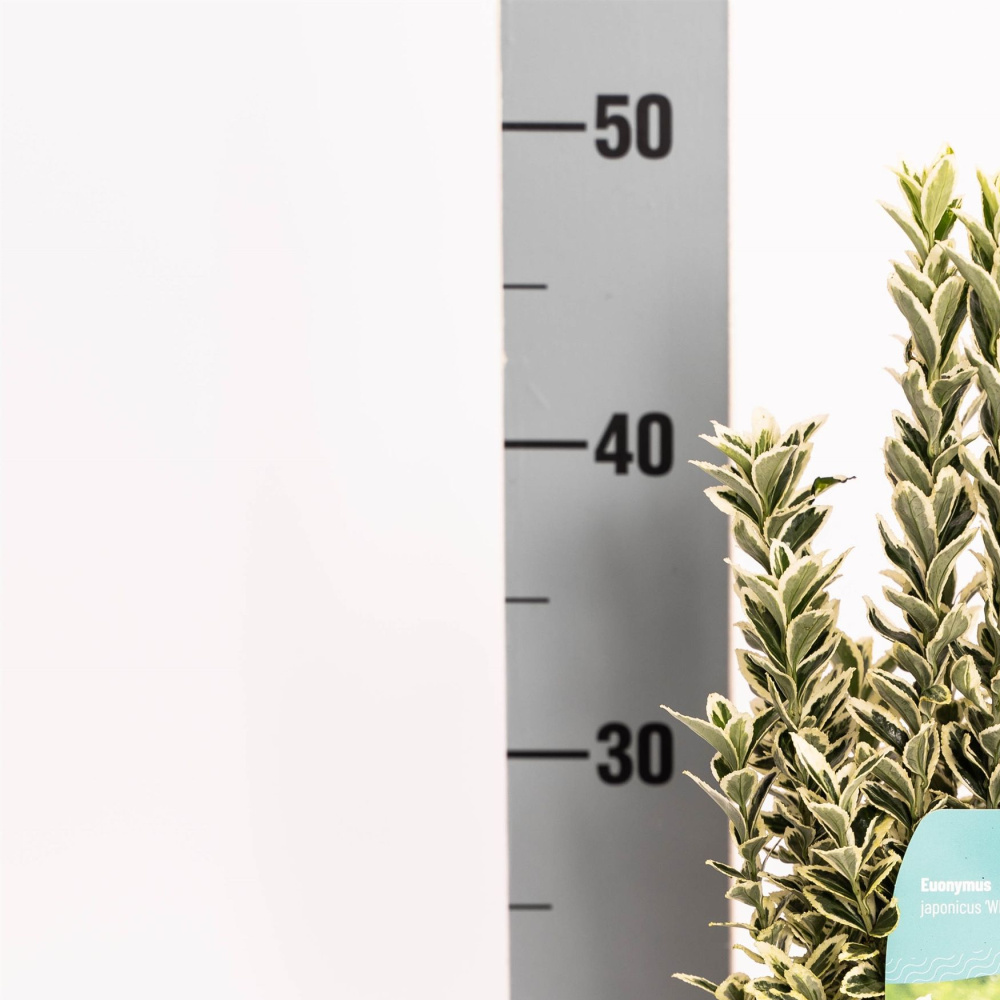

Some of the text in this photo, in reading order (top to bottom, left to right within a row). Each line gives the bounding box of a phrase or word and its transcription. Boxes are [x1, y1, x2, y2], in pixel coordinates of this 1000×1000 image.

[596, 94, 671, 159] 50
[595, 412, 674, 477] 40
[597, 721, 675, 786] 30
[920, 900, 981, 917] japonicus
[921, 878, 991, 895] Euonymus
